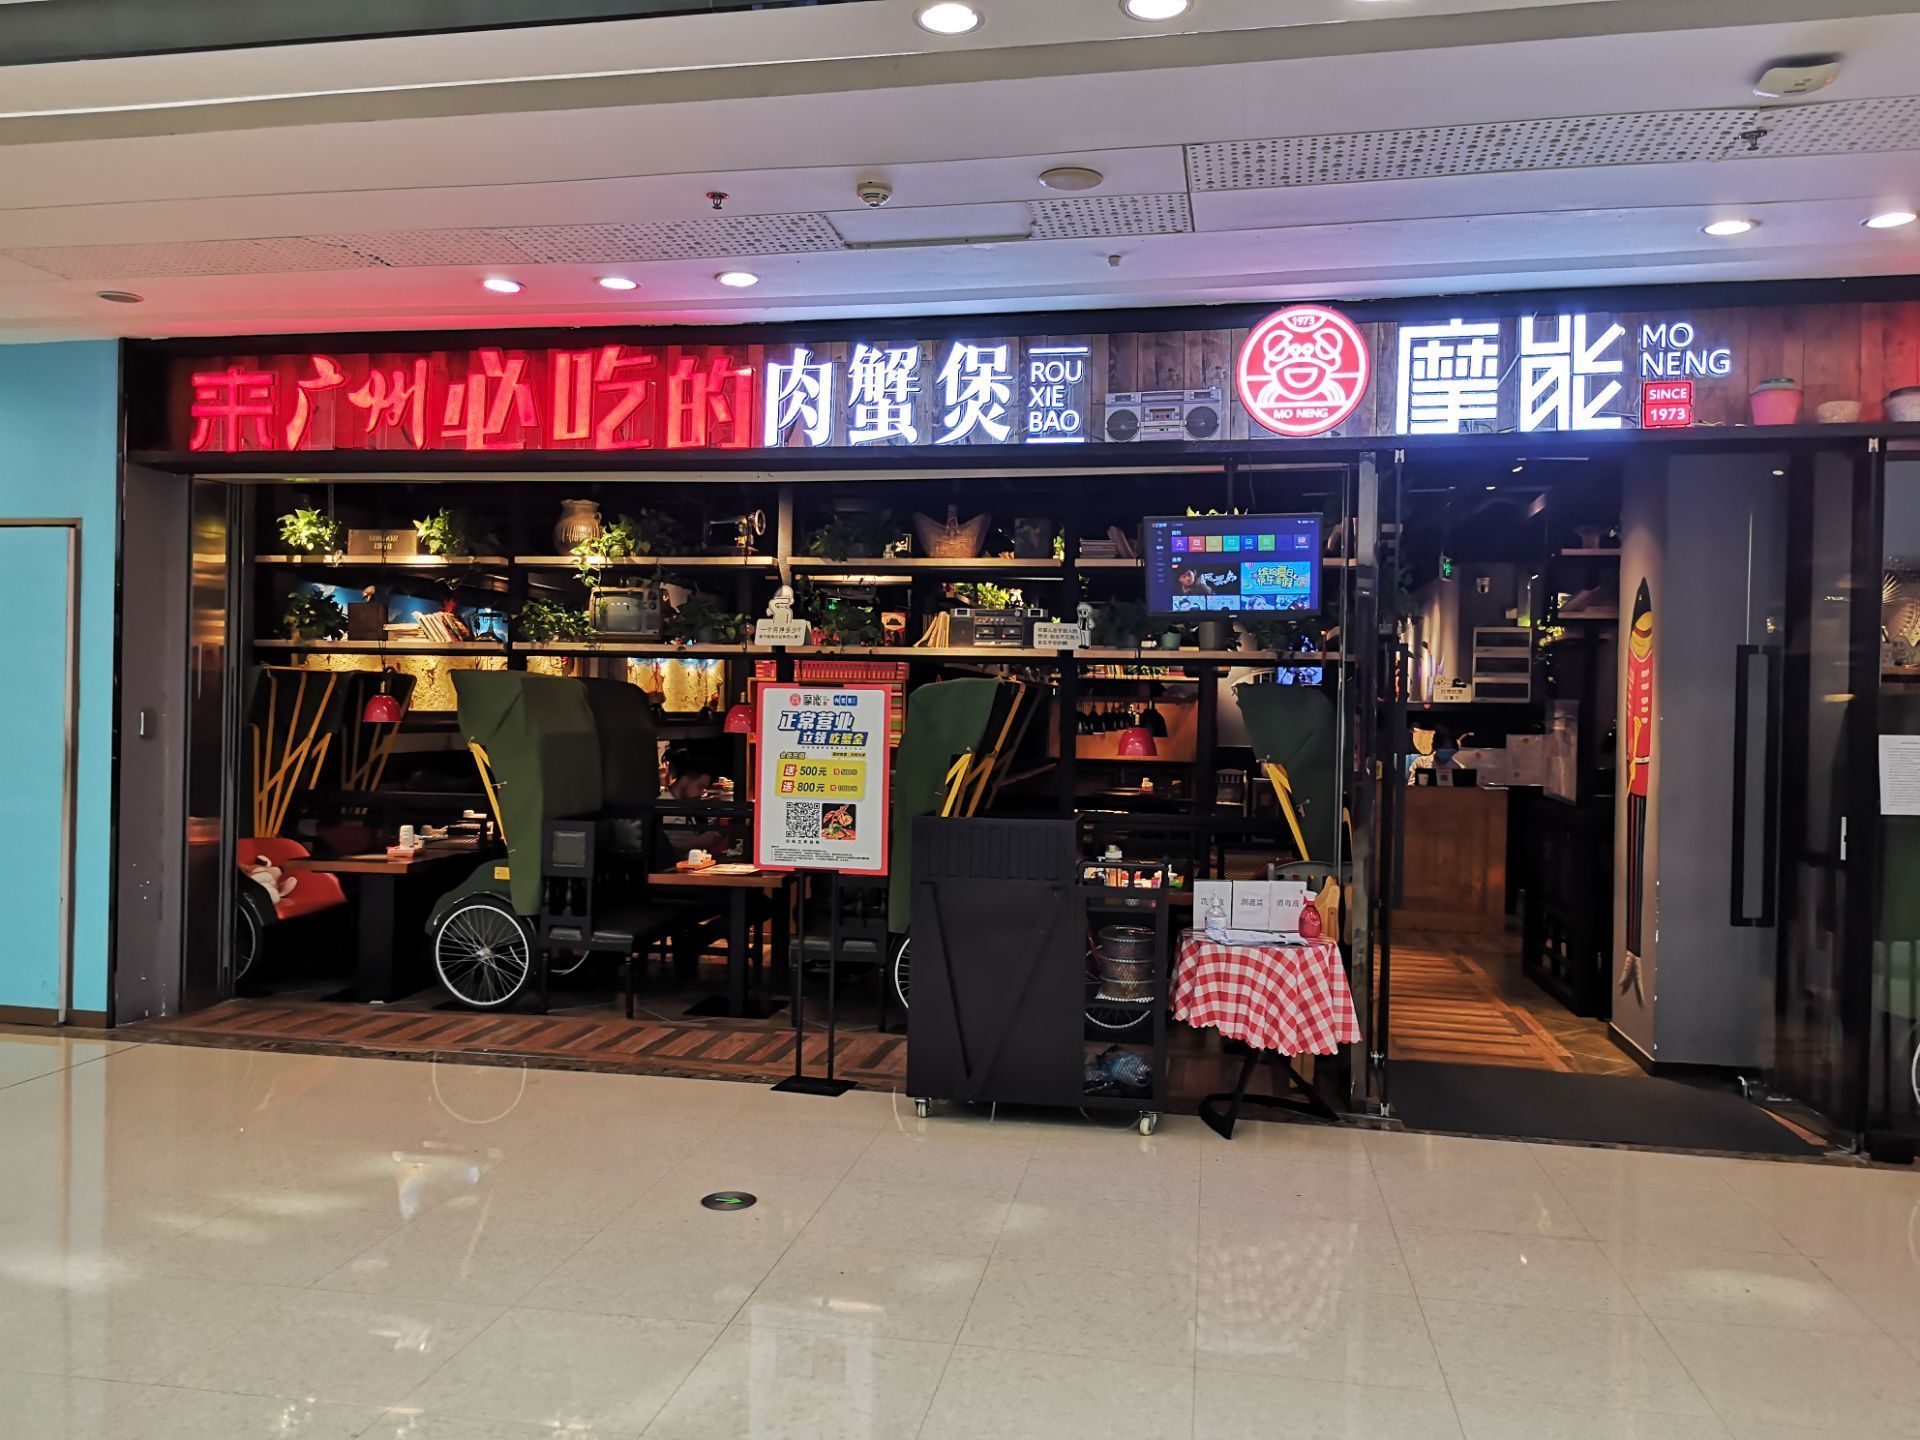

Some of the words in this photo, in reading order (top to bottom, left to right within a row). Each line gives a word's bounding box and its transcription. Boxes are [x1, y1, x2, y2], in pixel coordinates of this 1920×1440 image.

[1291, 315, 1316, 326] 1973
[1641, 323, 1694, 349] MO
[1031, 360, 1085, 384] ROU
[1641, 349, 1731, 377] NENG
[1395, 315, 1626, 434] 摩能
[1029, 385, 1066, 409] XIE
[1649, 388, 1688, 400] SINCE
[1029, 410, 1081, 433] BAO
[1273, 409, 1293, 419] MO
[1296, 408, 1329, 418] NENG
[1649, 408, 1686, 421] 1973
[778, 711, 855, 731] 正常营业
[784, 764, 796, 776] 送
[799, 766, 827, 776] 500元
[782, 780, 794, 792] 送
[797, 783, 825, 792] 800元
